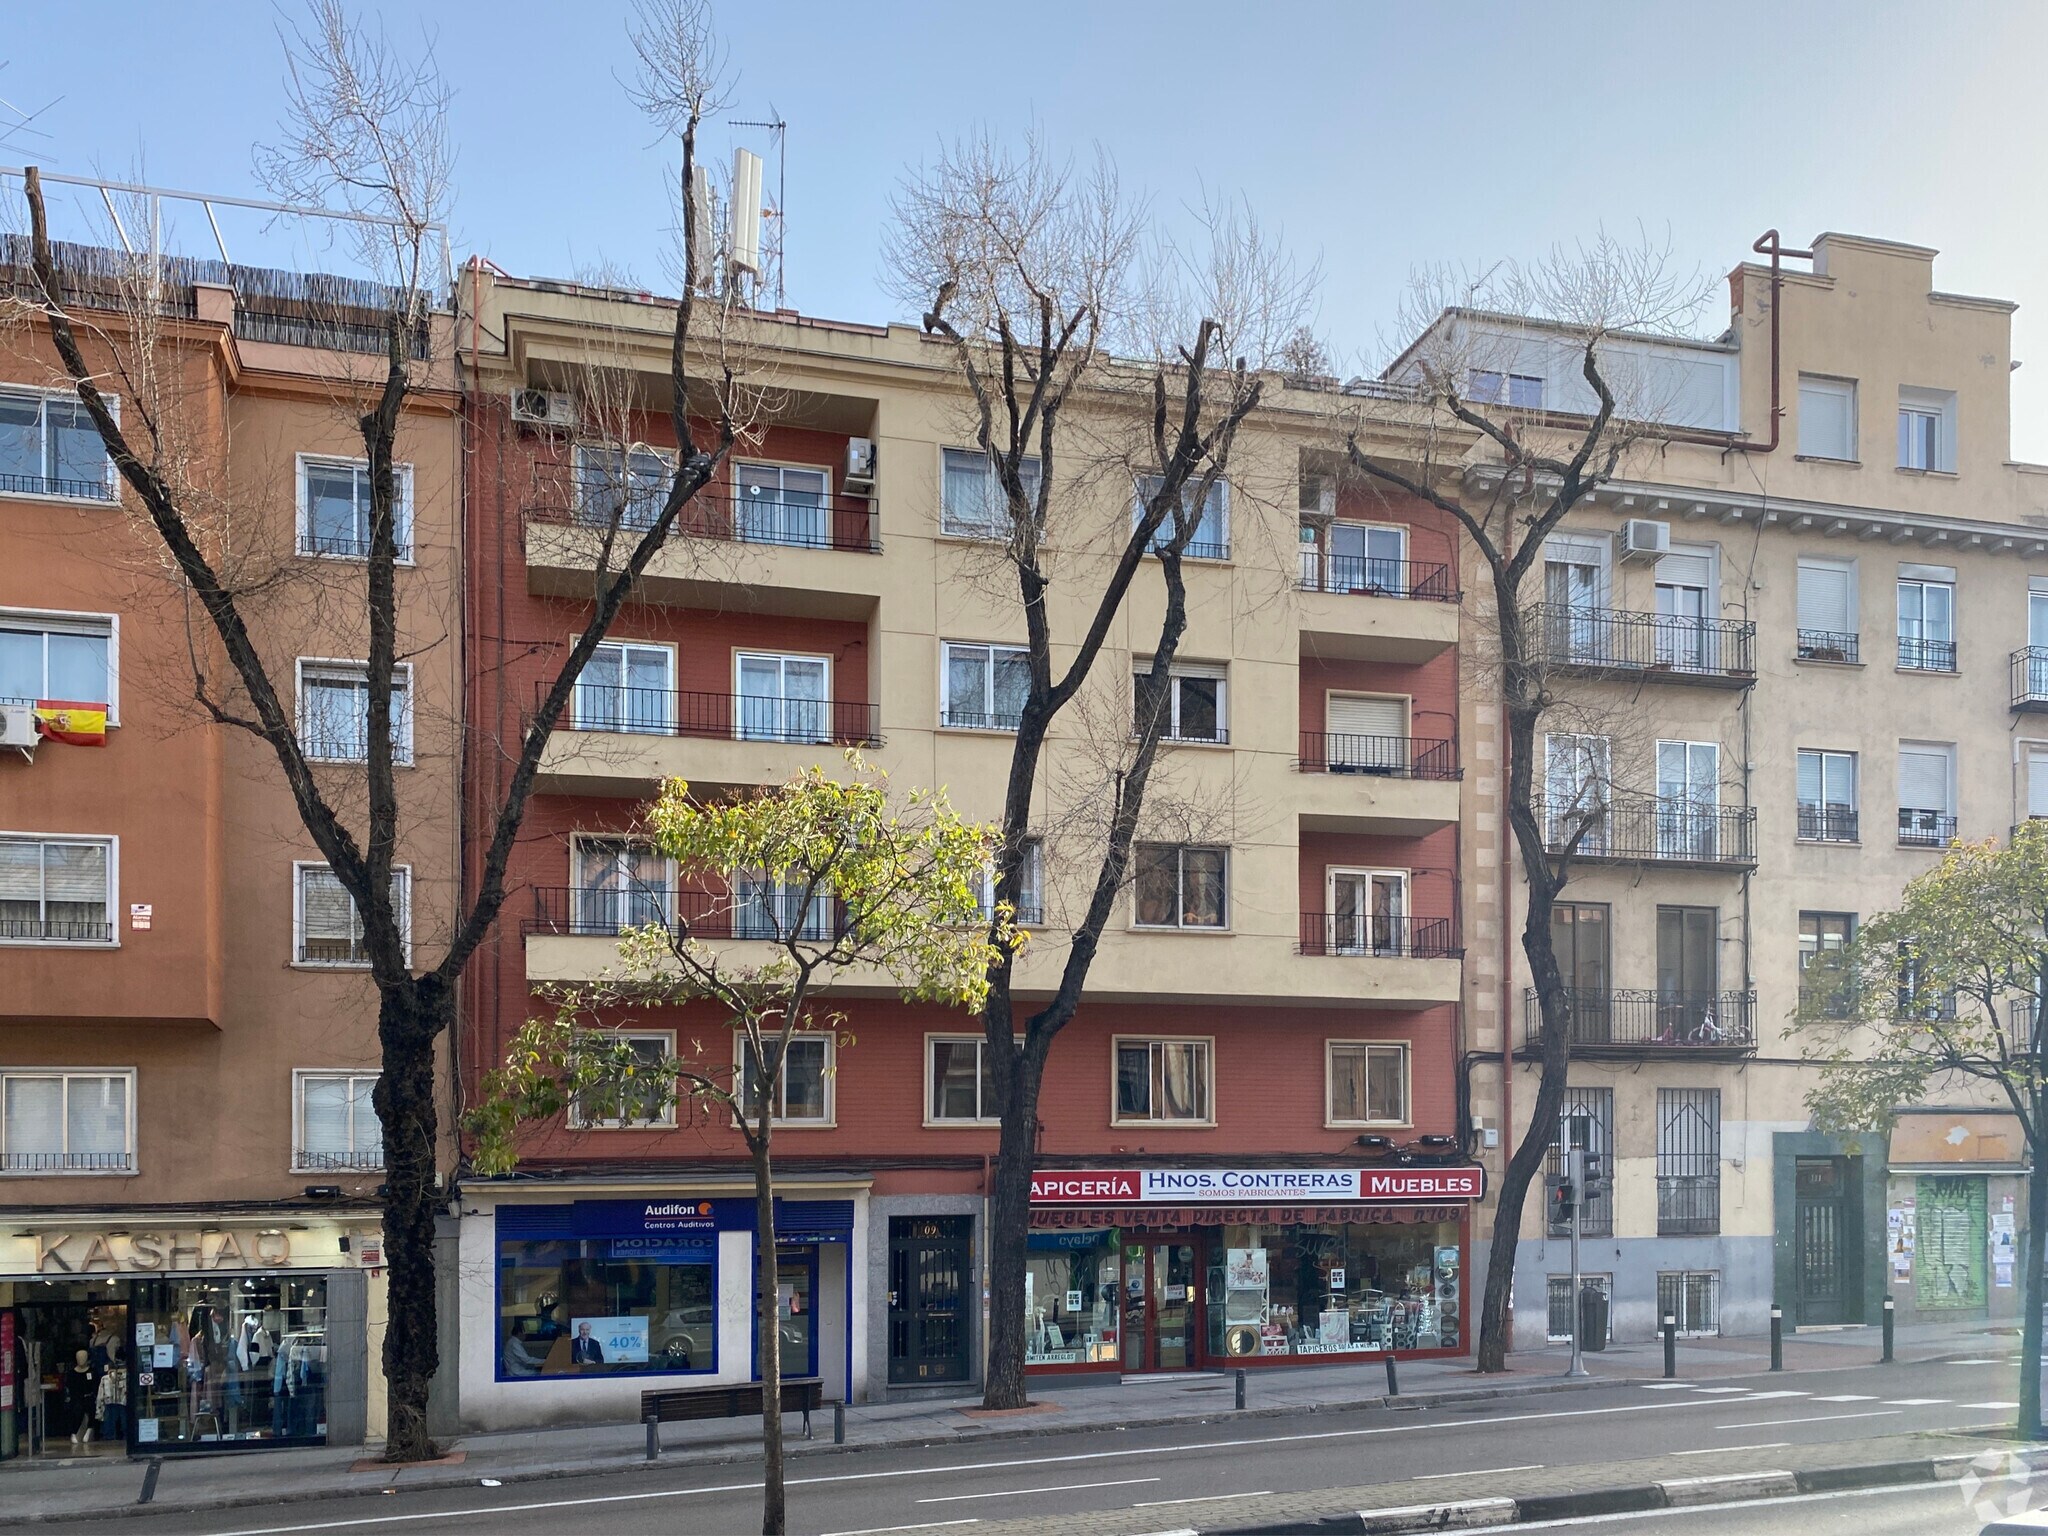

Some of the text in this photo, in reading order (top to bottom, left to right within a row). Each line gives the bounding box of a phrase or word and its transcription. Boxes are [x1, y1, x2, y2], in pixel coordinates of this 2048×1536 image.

[1030, 1177, 1133, 1196] APICERÍA
[1148, 1172, 1353, 1188] HNOS. CONTRERAS
[1371, 1176, 1473, 1194] MUEBLES
[1198, 1188, 1306, 1197] SOMOS FABRICANTES
[645, 1204, 695, 1216] Audifon
[1123, 1210, 1181, 1223] VENTA
[1193, 1209, 1270, 1223] DIRECTA
[1280, 1208, 1304, 1221] DE
[35, 1229, 291, 1272] KASHAQ
[608, 1336, 641, 1349] 40%
[1299, 1344, 1338, 1354] TAPICEROS
